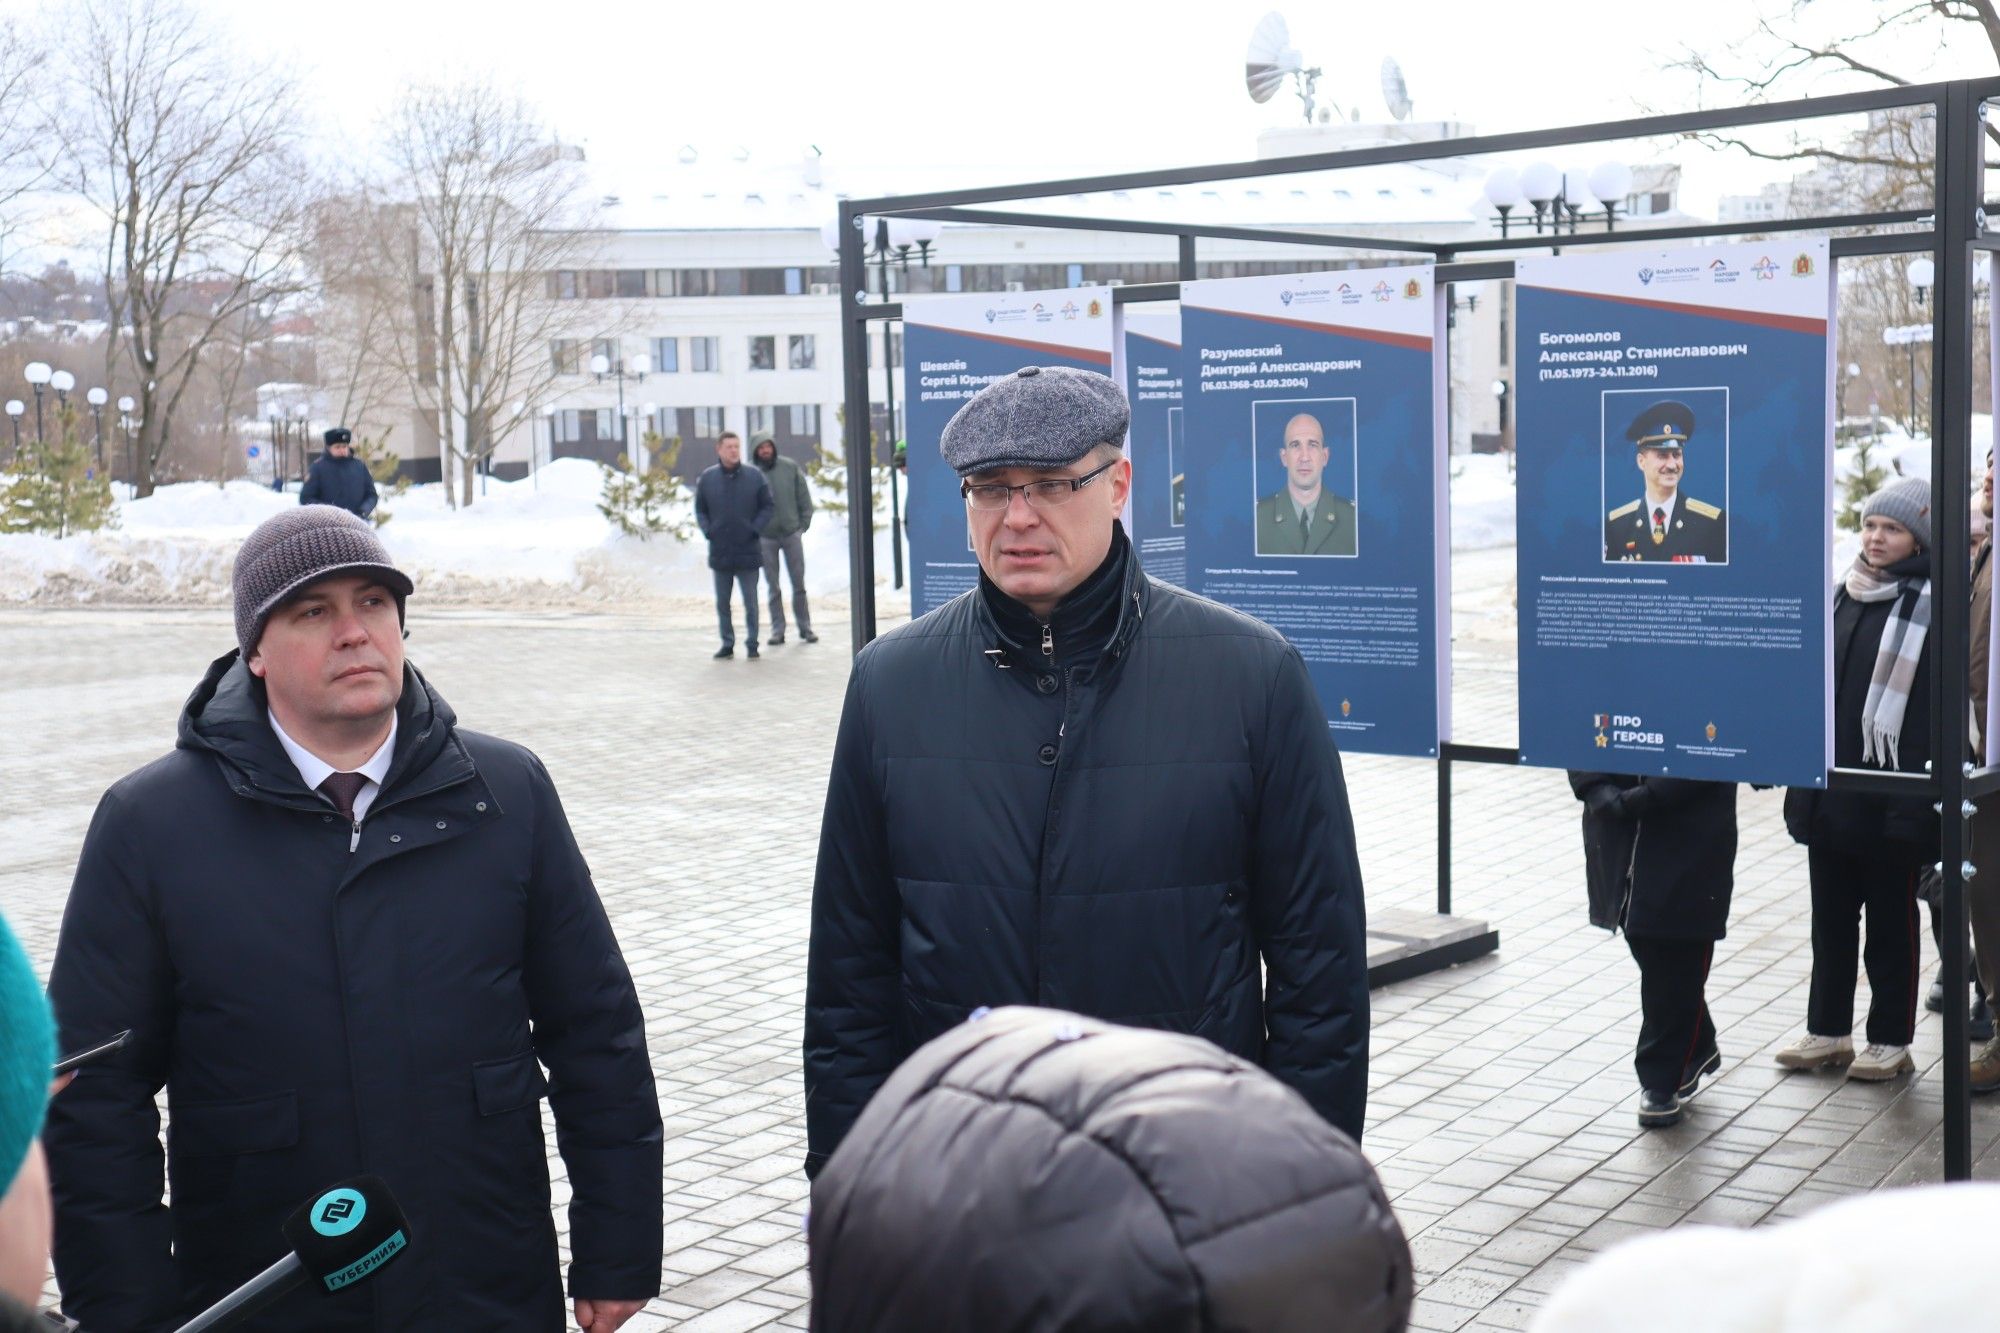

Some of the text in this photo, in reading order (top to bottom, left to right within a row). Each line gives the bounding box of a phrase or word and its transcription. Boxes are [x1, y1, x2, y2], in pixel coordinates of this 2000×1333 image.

[1539, 330, 1621, 346] Богомолов
[1201, 344, 1283, 362] Разумовский
[1539, 344, 1748, 363] Александр Станиславович
[920, 360, 967, 372] Шевелёв
[1201, 359, 1362, 378] Дмитрий Александрович
[920, 374, 957, 389] Сергей
[1613, 715, 1641, 728] ПРО
[1613, 730, 1664, 745] ГЕРОЕВ
[329, 1240, 397, 1286] ГУБЕРНИЯ
